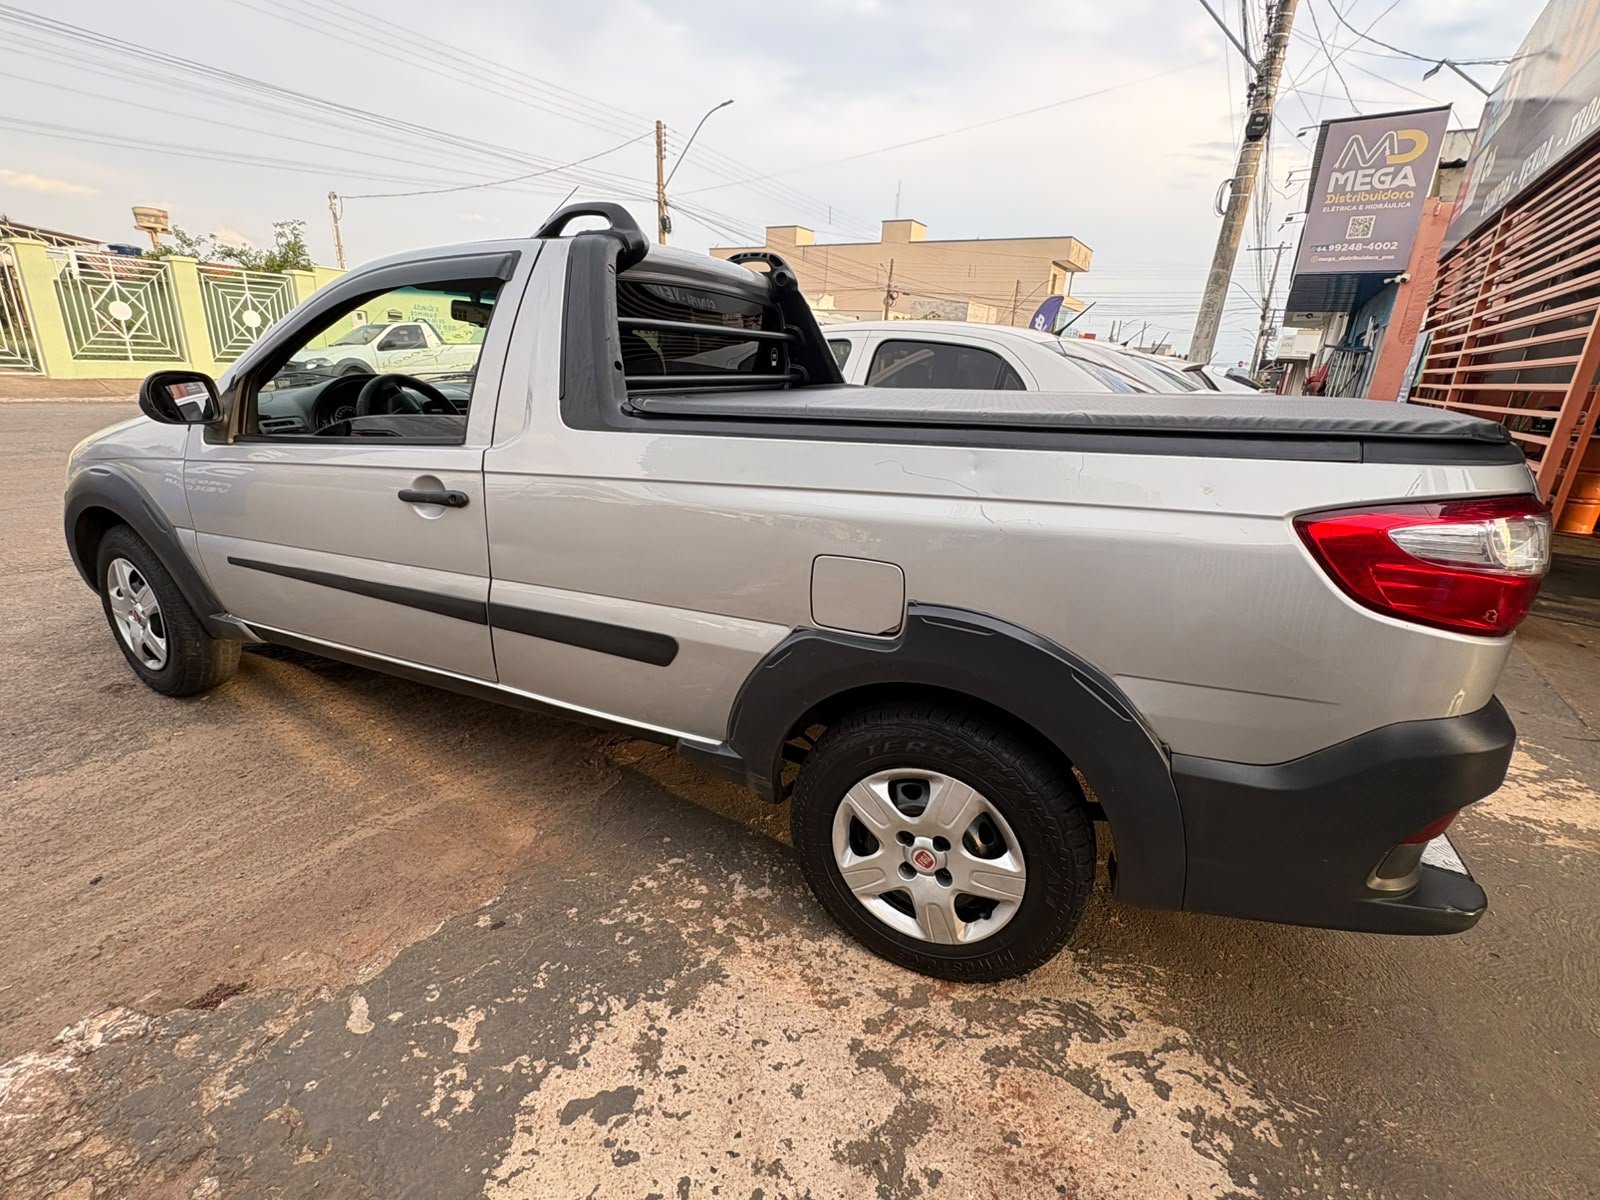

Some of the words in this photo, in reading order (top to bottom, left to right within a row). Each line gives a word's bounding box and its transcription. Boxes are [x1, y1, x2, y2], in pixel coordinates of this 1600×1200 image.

[1327, 165, 1416, 193] MEGA
[1325, 189, 1415, 204] Distribuidora
[1322, 203, 1357, 213] ELÉTRICA
[1364, 201, 1411, 210] HIDRÁULICA
